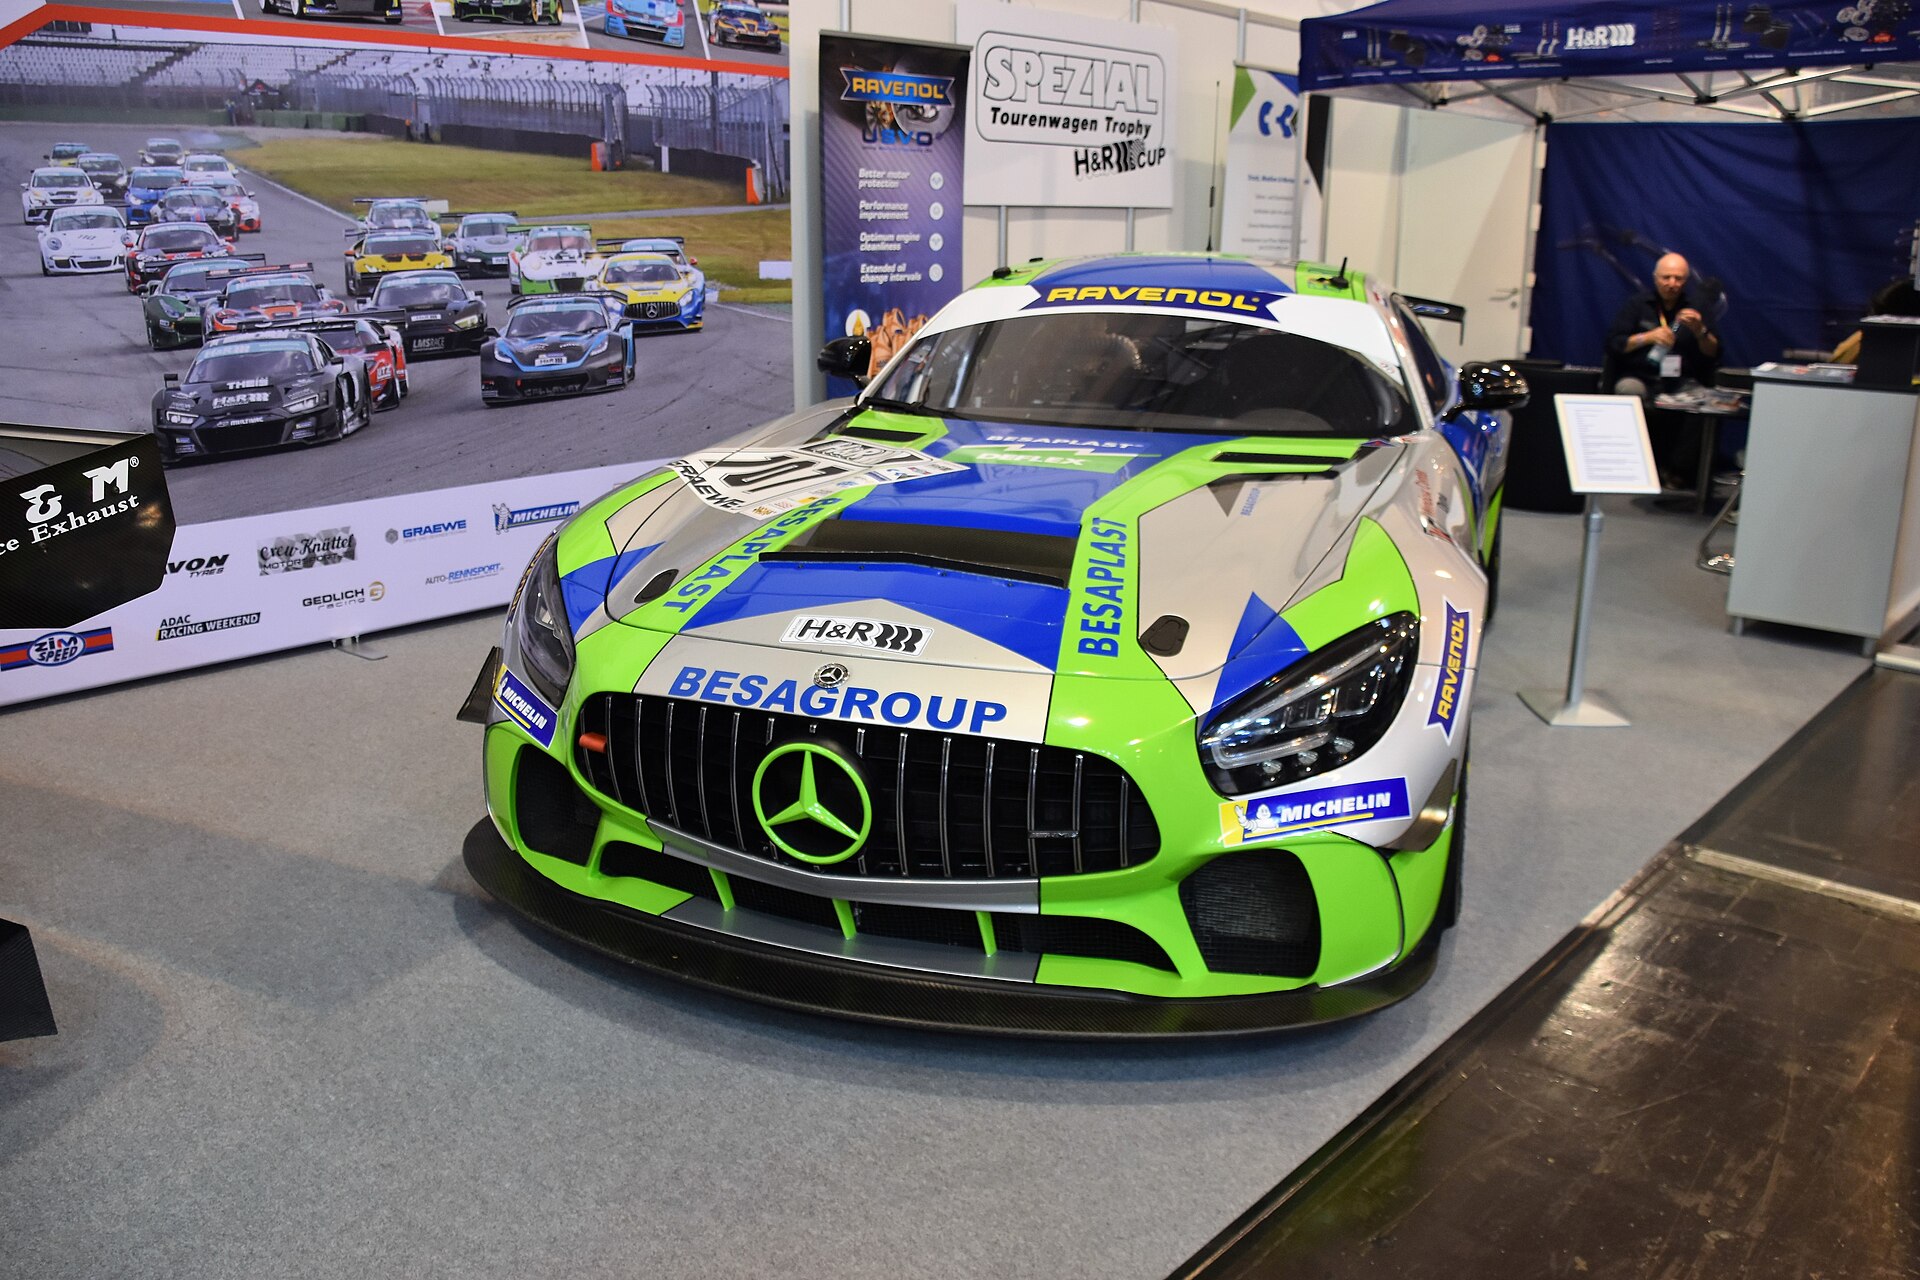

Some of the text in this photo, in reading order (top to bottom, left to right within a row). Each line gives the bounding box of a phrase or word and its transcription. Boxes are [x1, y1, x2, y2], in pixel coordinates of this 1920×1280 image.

[1566, 25, 1608, 48] H&R
[852, 77, 944, 99] RAVENOL
[983, 45, 1158, 115] SPEZIAL
[990, 106, 1151, 139] Tourenwagen Trophy
[1074, 144, 1166, 176] H&R CUP
[858, 179, 899, 190] protection
[859, 168, 886, 180] Better
[859, 200, 909, 211] Performance
[859, 209, 909, 222] improvement
[860, 232, 920, 244] Optimum engine
[860, 241, 902, 252] cleanliness
[860, 263, 896, 274] Extended
[860, 272, 922, 284] change intervals
[1046, 286, 1258, 312] RAVENOL
[986, 434, 1136, 450] BESAPLAST
[28, 494, 140, 544] Exhaust
[512, 504, 580, 524] MICHELIN
[402, 519, 467, 539] GRAEWE
[165, 554, 230, 575] VON
[662, 496, 842, 614] BESAPLAST
[189, 567, 224, 579] TYRES
[302, 588, 364, 607] GEDLICH
[1077, 517, 1128, 658] BESAPLAST
[160, 614, 191, 628] ADAC
[160, 614, 259, 640] RACING WEEKEND
[797, 619, 874, 642] H&R
[37, 646, 79, 662] SPEED
[1437, 618, 1465, 720] RAVENOL
[502, 686, 548, 730] MICHELIN
[667, 666, 1008, 734] BESAGROUP
[1279, 791, 1391, 823] MICHELIN
